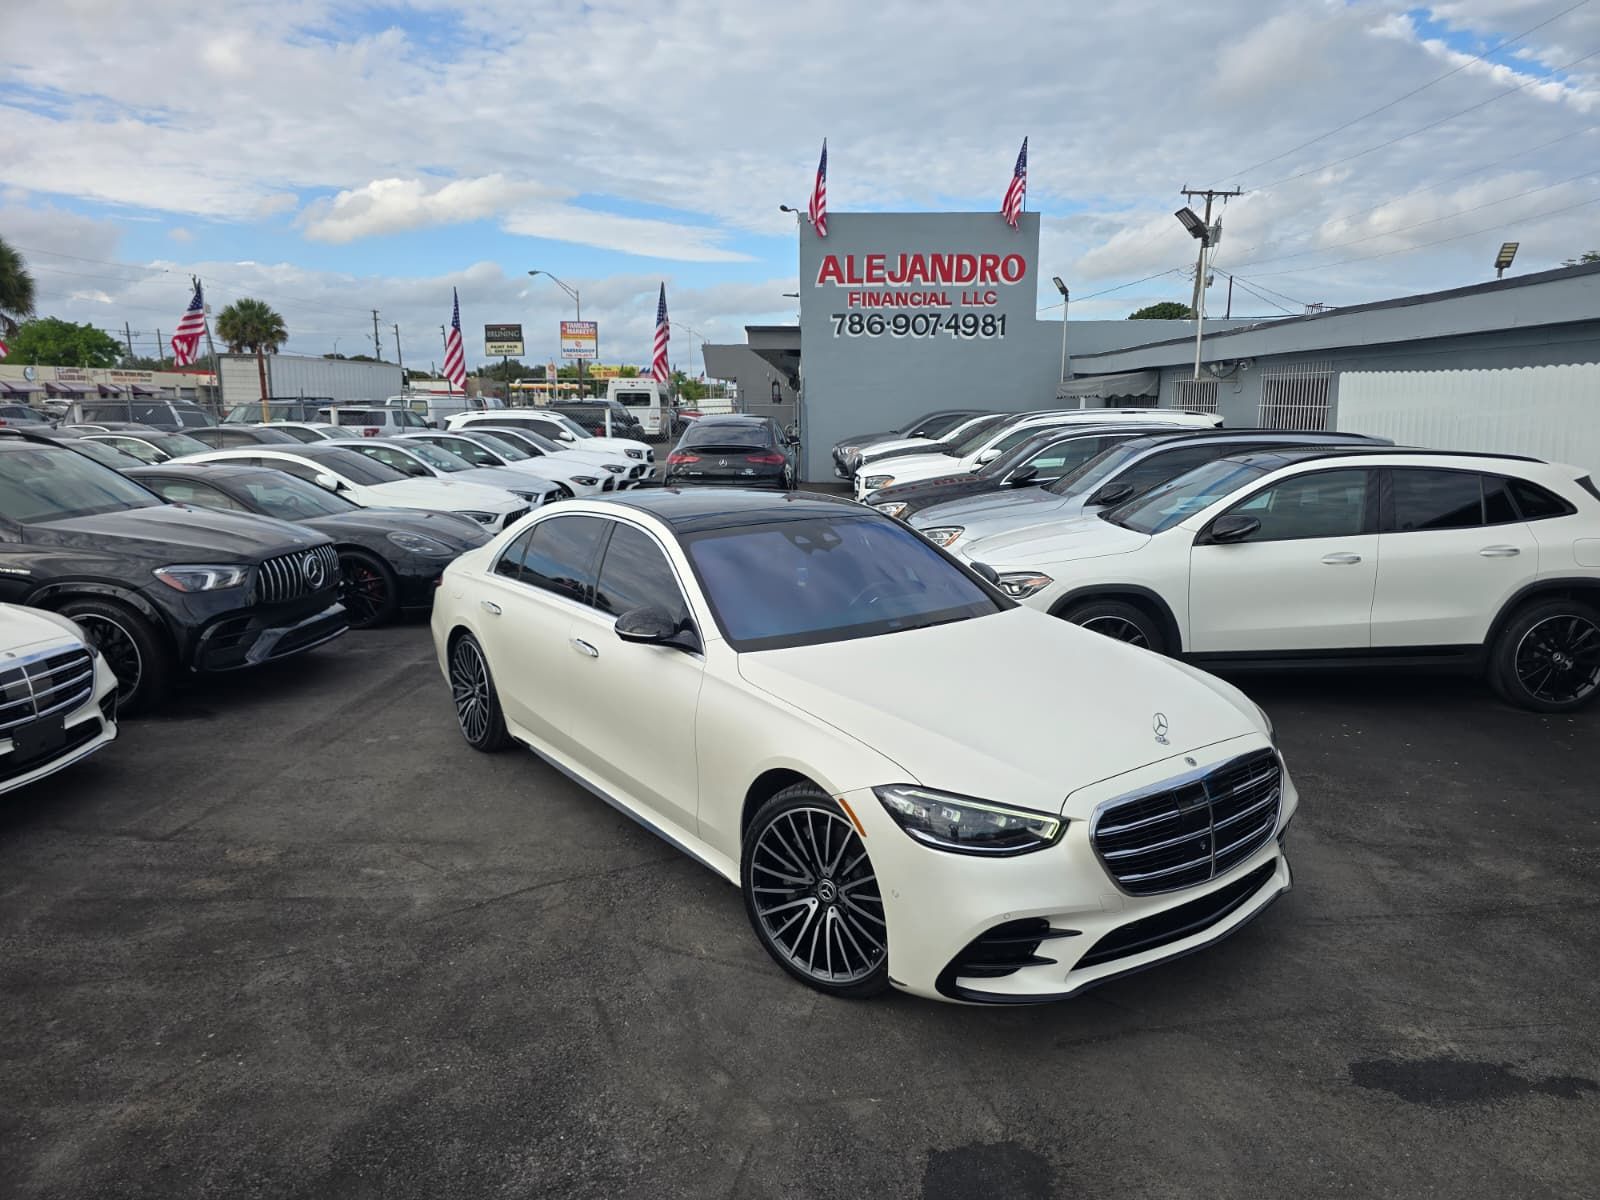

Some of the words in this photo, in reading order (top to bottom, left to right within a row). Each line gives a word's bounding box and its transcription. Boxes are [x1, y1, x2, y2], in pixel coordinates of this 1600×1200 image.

[815, 253, 1026, 287] ALEJANDRO
[848, 291, 952, 309] FINANCIAL
[961, 291, 998, 307] LLC
